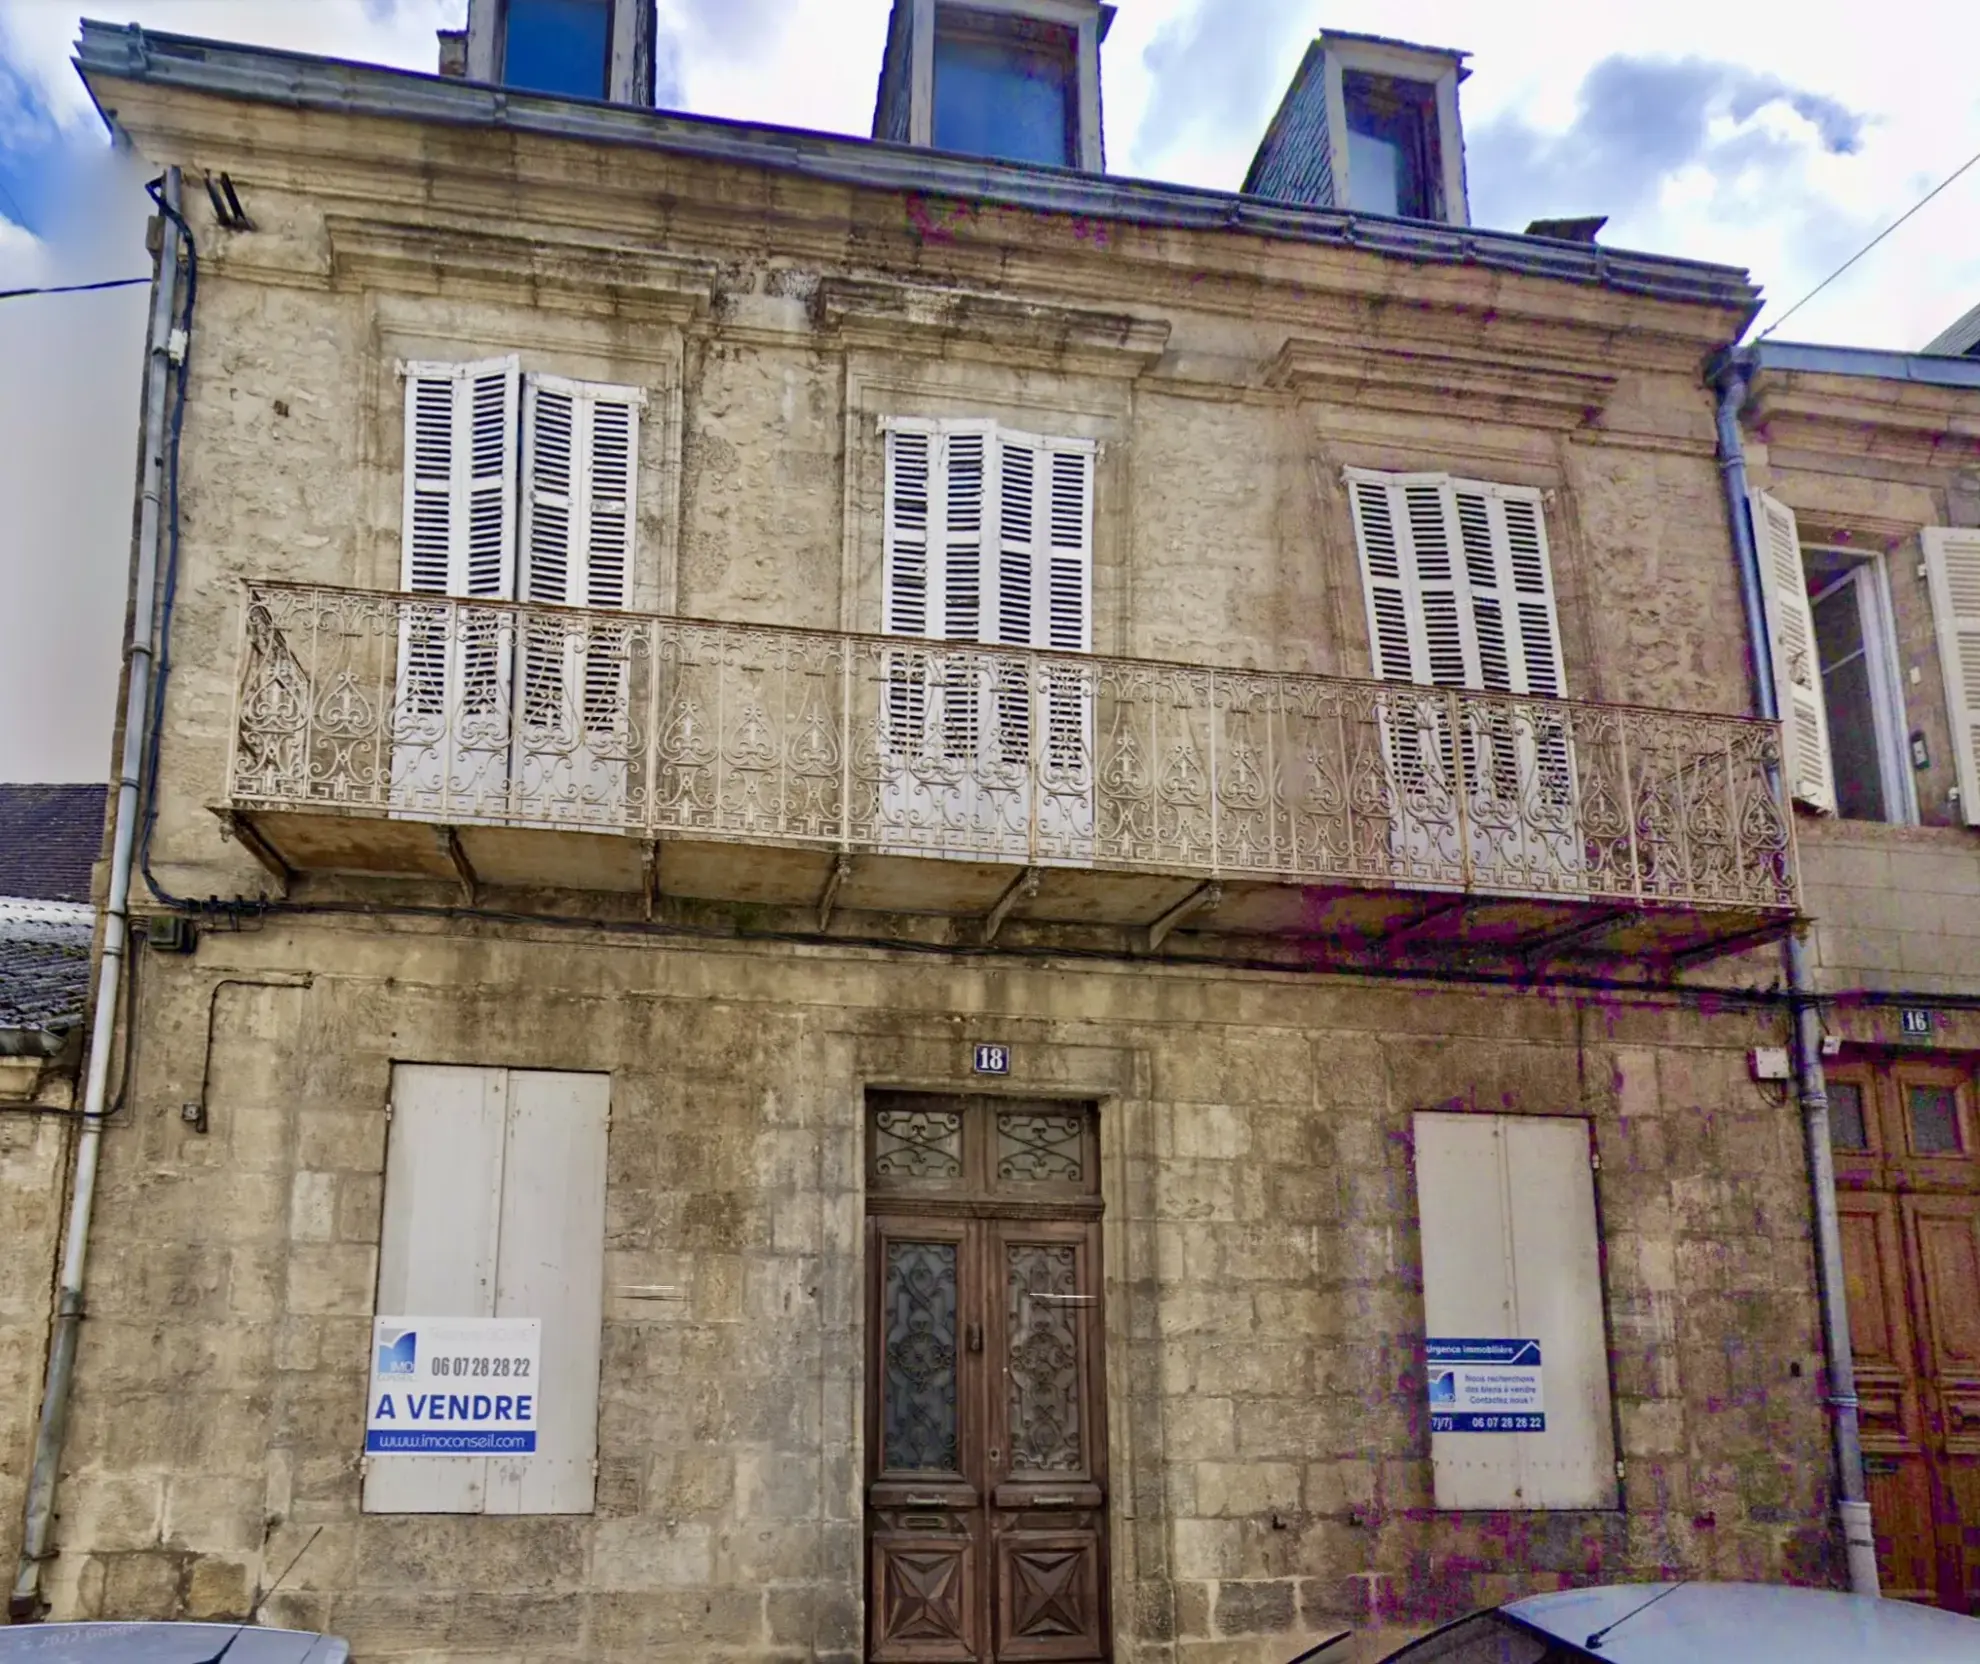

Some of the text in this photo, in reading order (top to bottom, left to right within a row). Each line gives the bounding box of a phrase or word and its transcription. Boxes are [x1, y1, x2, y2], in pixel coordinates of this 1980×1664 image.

[1907, 1011, 1926, 1030] 16
[980, 1047, 1003, 1070] 18
[432, 1357, 530, 1376] 06 07 28 28 22
[375, 1394, 532, 1420] A VENDRE
[1472, 1417, 1485, 1428] 06
[1486, 1417, 1499, 1428] 07
[1501, 1417, 1514, 1428] 28
[1515, 1417, 1528, 1428] 28
[1530, 1417, 1542, 1428] 22
[379, 1434, 525, 1448] www.imoconseil.com
